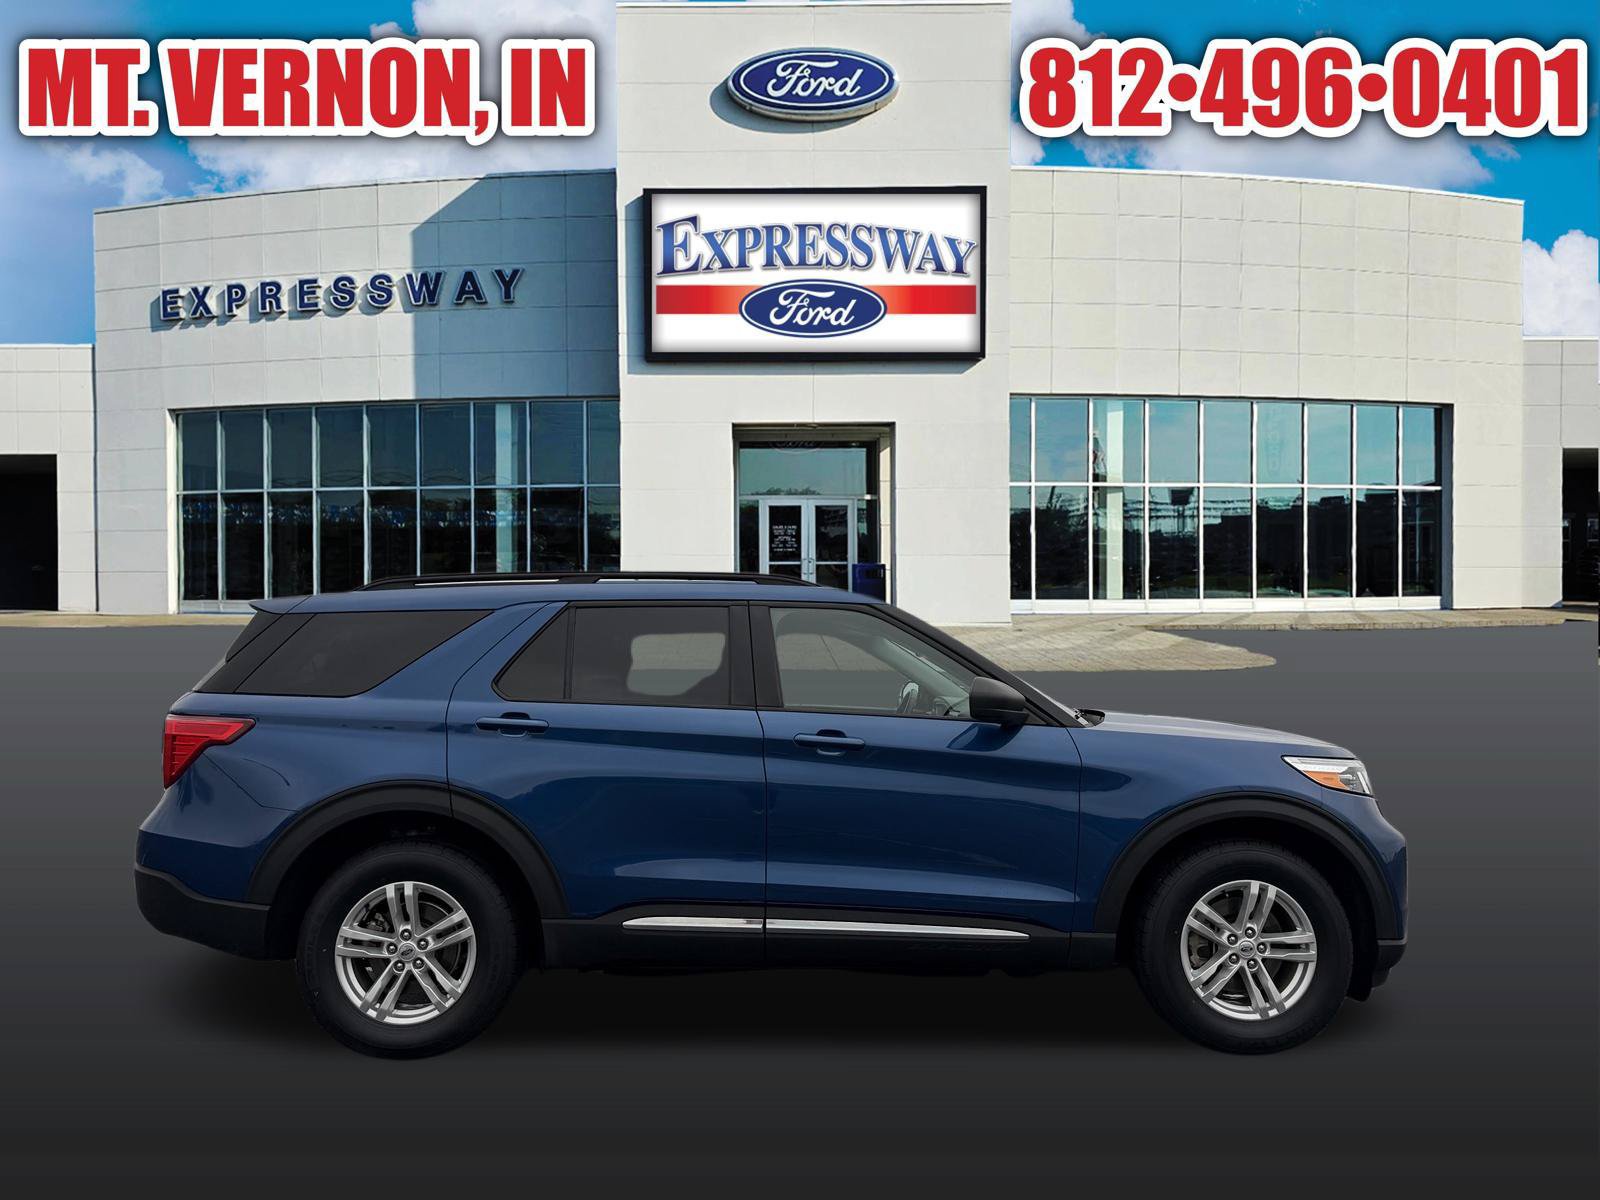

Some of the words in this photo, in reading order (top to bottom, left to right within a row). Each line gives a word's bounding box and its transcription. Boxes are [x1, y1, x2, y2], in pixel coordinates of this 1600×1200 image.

[766, 59, 864, 98] Ford
[158, 268, 526, 322] EXPRESSWAY
[769, 288, 857, 327] Ford
